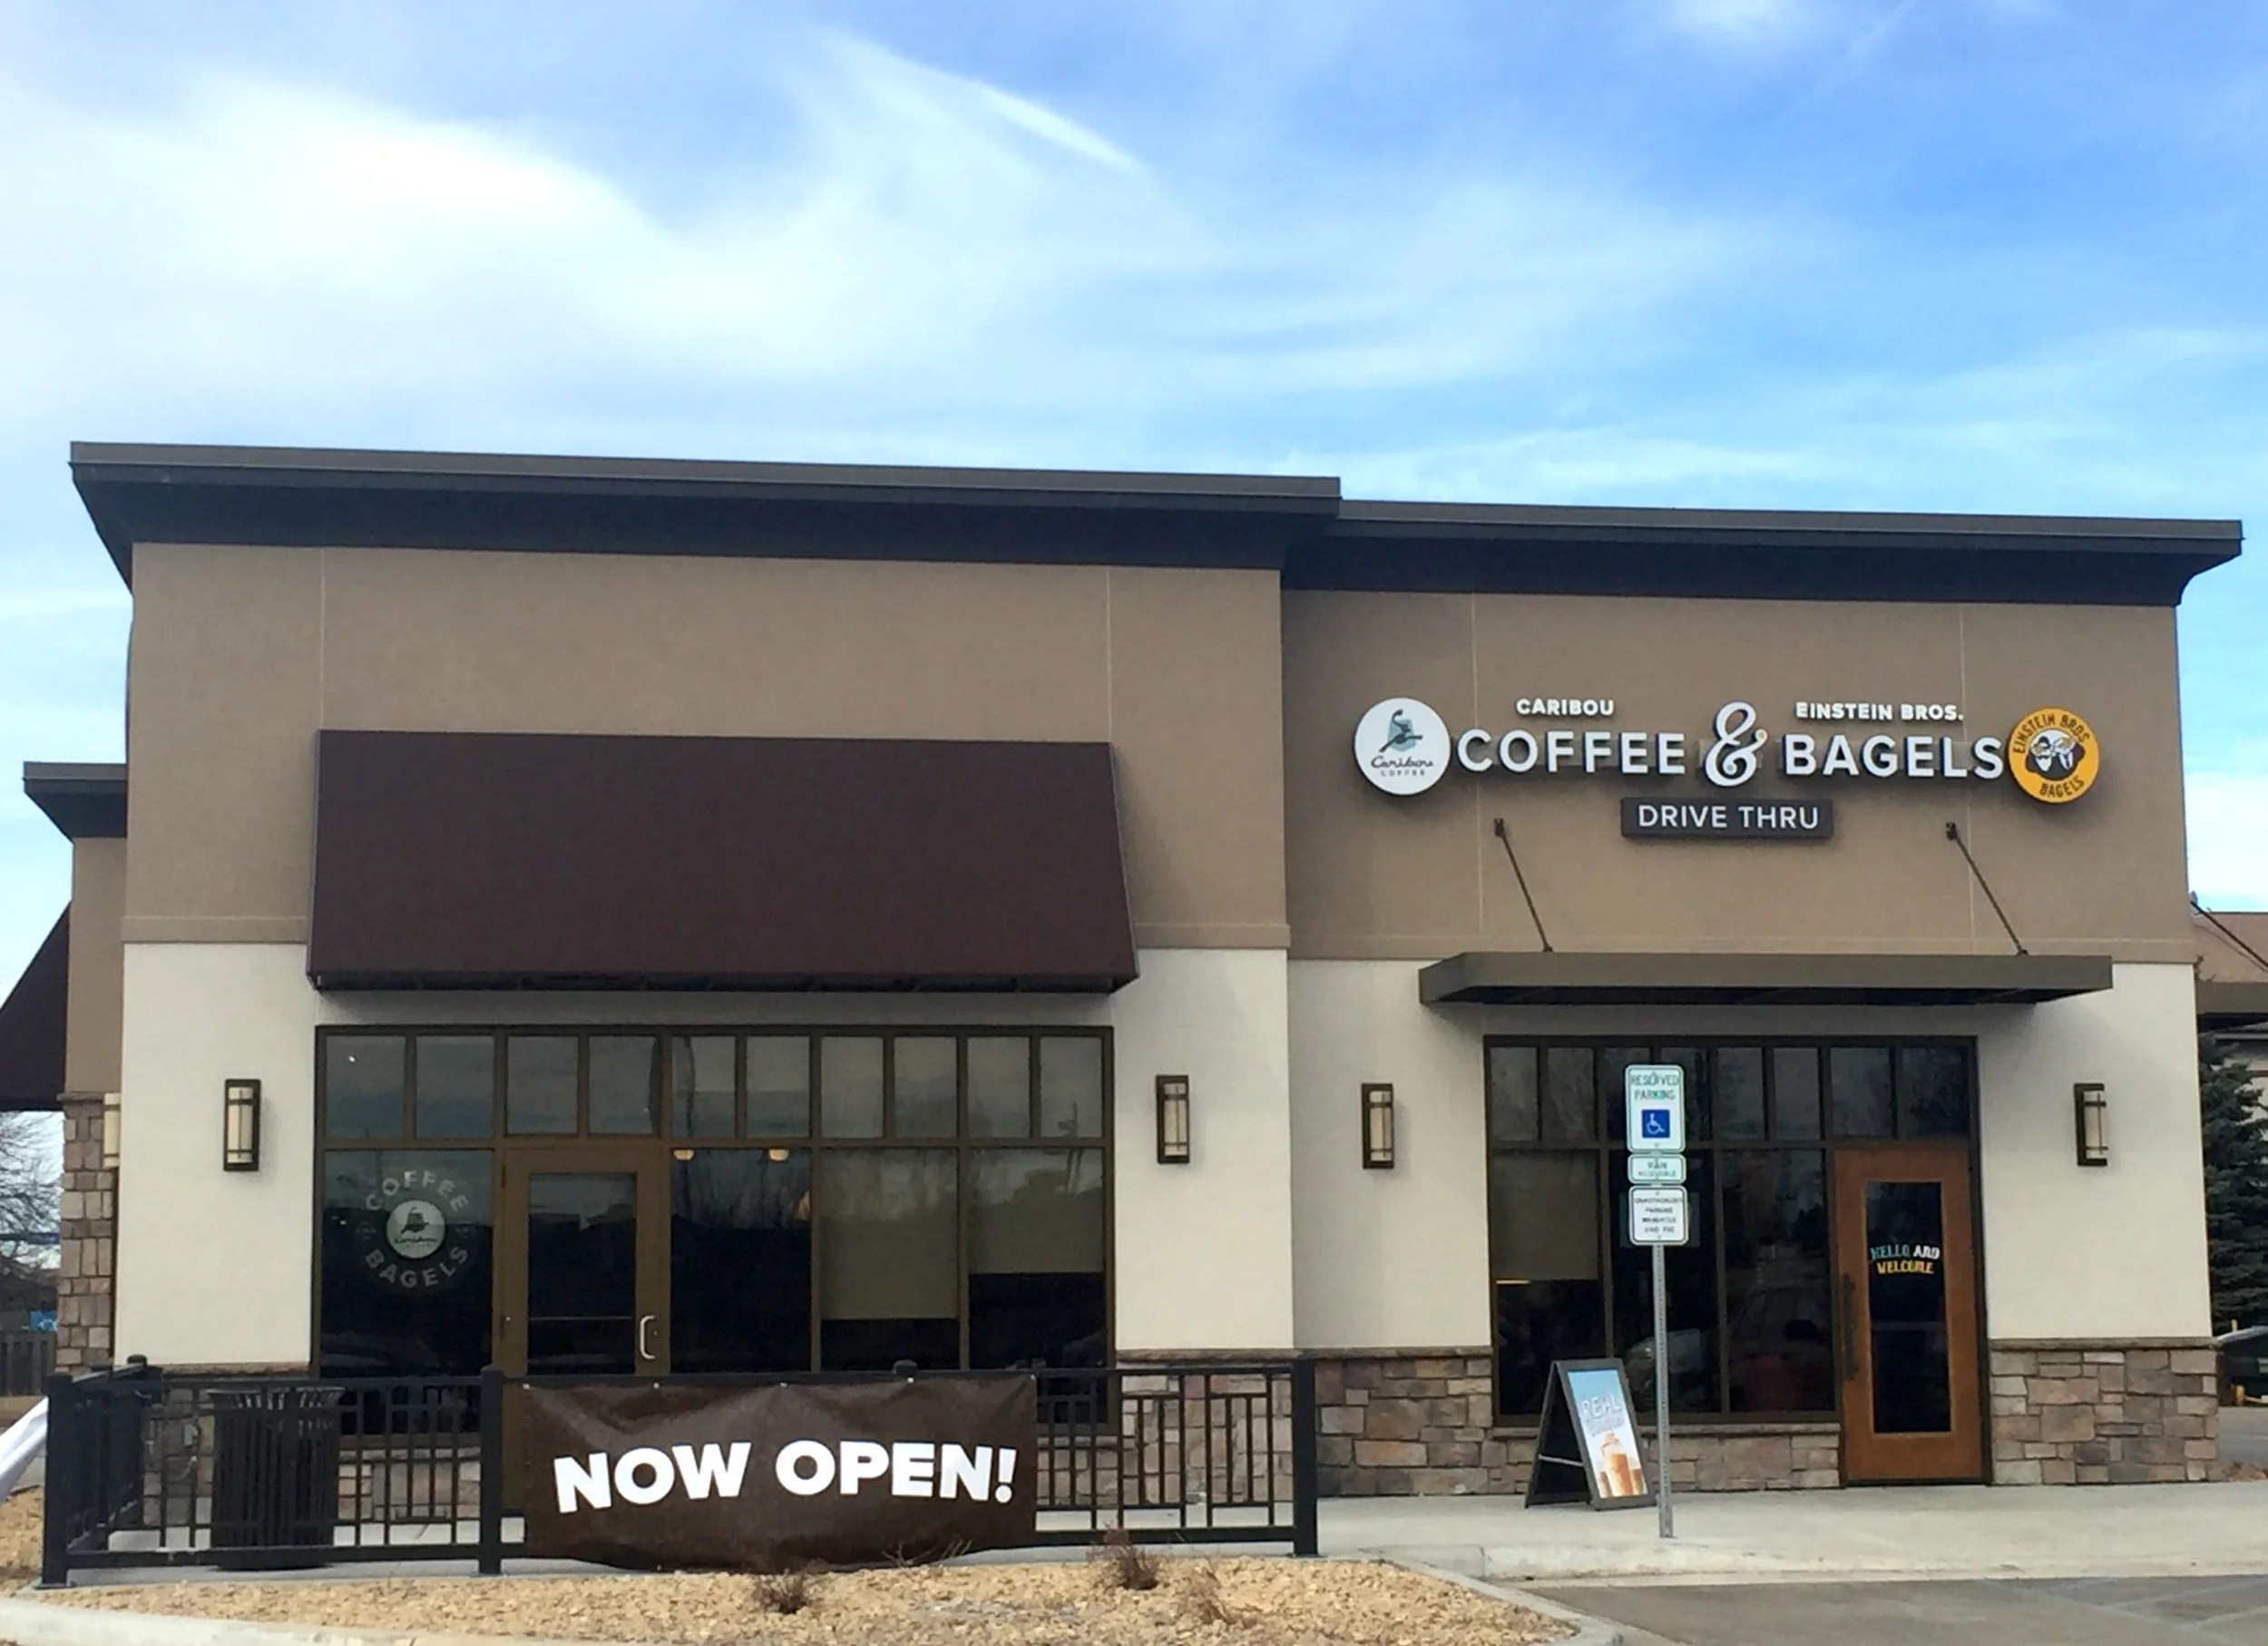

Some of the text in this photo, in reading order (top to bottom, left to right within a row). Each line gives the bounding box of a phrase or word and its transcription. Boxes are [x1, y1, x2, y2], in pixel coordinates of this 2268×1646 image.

[1516, 698, 1615, 717] CARIBOU
[1795, 701, 1964, 721] EINSTEIN BROS.
[1457, 701, 2003, 787] COFFEE & BAGELS
[2012, 713, 2056, 754] EINSTEIN
[1371, 755, 1434, 769] Caribou
[2038, 774, 2085, 798] BAGELS
[1637, 804, 1819, 829] DRIVE THRU
[1631, 1073, 1679, 1086] RESERVED
[1634, 1089, 1676, 1101] PARKING
[366, 1170, 469, 1211] COFFEE
[365, 1247, 468, 1288] BAGELS
[553, 1439, 1017, 1514] NOW OPEN!
